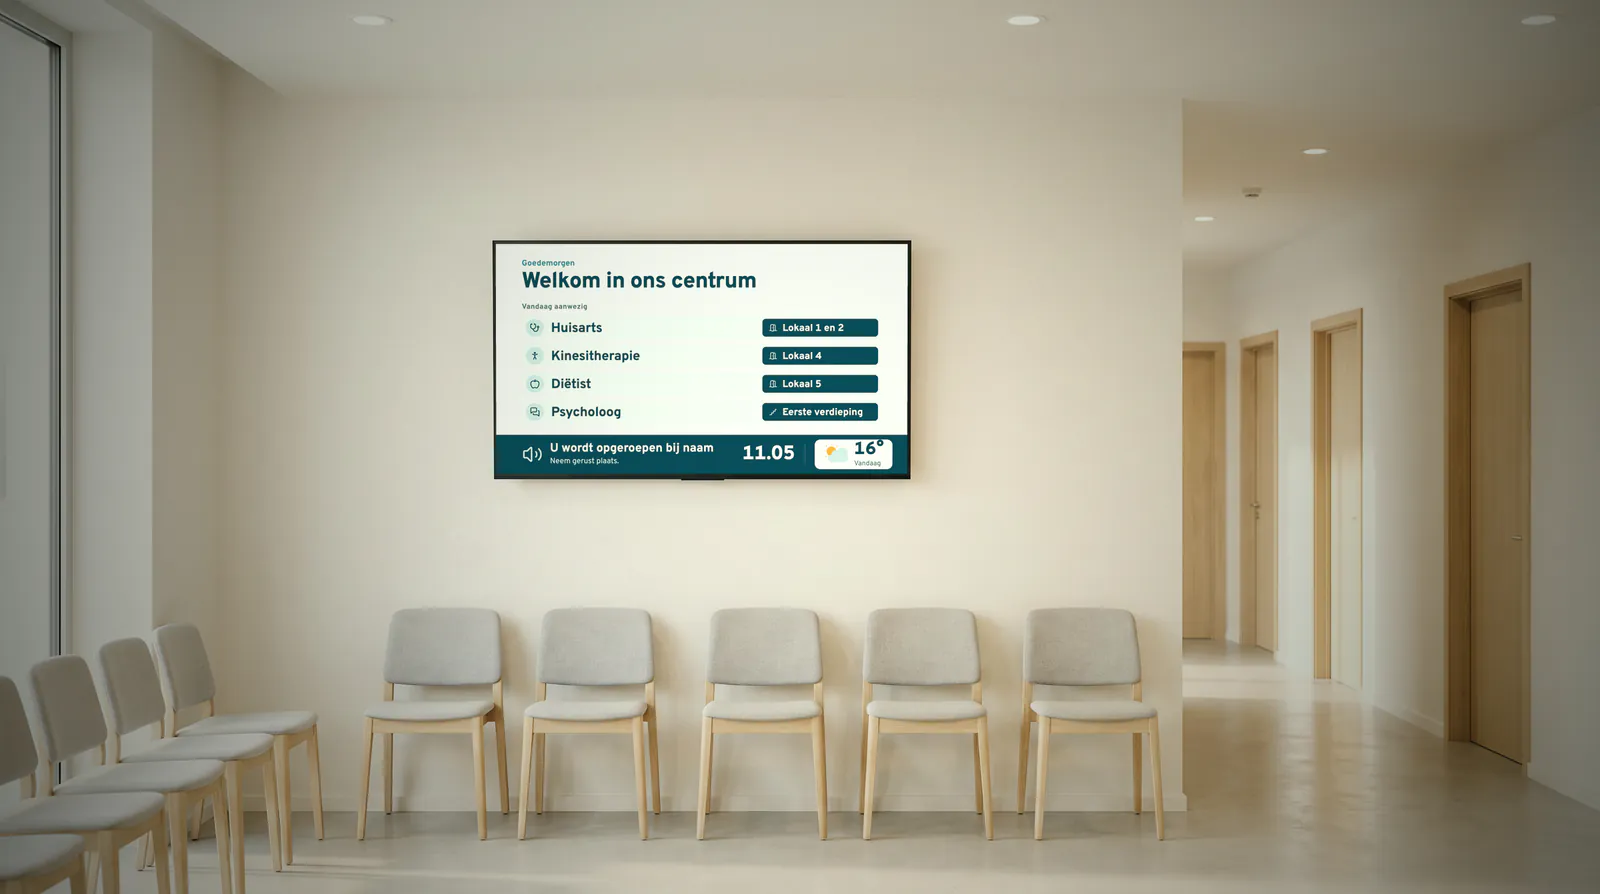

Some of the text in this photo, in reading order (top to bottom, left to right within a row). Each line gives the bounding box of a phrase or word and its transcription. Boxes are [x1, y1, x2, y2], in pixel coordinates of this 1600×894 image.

[522, 259, 575, 268] Goedemorgen
[522, 271, 757, 289] Welkom in ons centrum
[522, 303, 588, 311] Vandaag aanwezig
[551, 321, 603, 333] Huisarts
[782, 323, 845, 333] Lokaal 1 en 2
[551, 350, 641, 363] Kinesitherapie
[782, 351, 822, 361] Lokaal 4
[551, 378, 592, 390] Diëtist
[782, 379, 822, 389] Lokaal 5
[551, 406, 622, 420] Psycholoog
[782, 407, 864, 418] Eerste verdieping
[549, 442, 714, 455] U wordt opgeroepen bij naam
[743, 444, 795, 461] 11.05
[854, 439, 884, 455] 16°
[549, 457, 620, 466] Neem gerust plaats.
